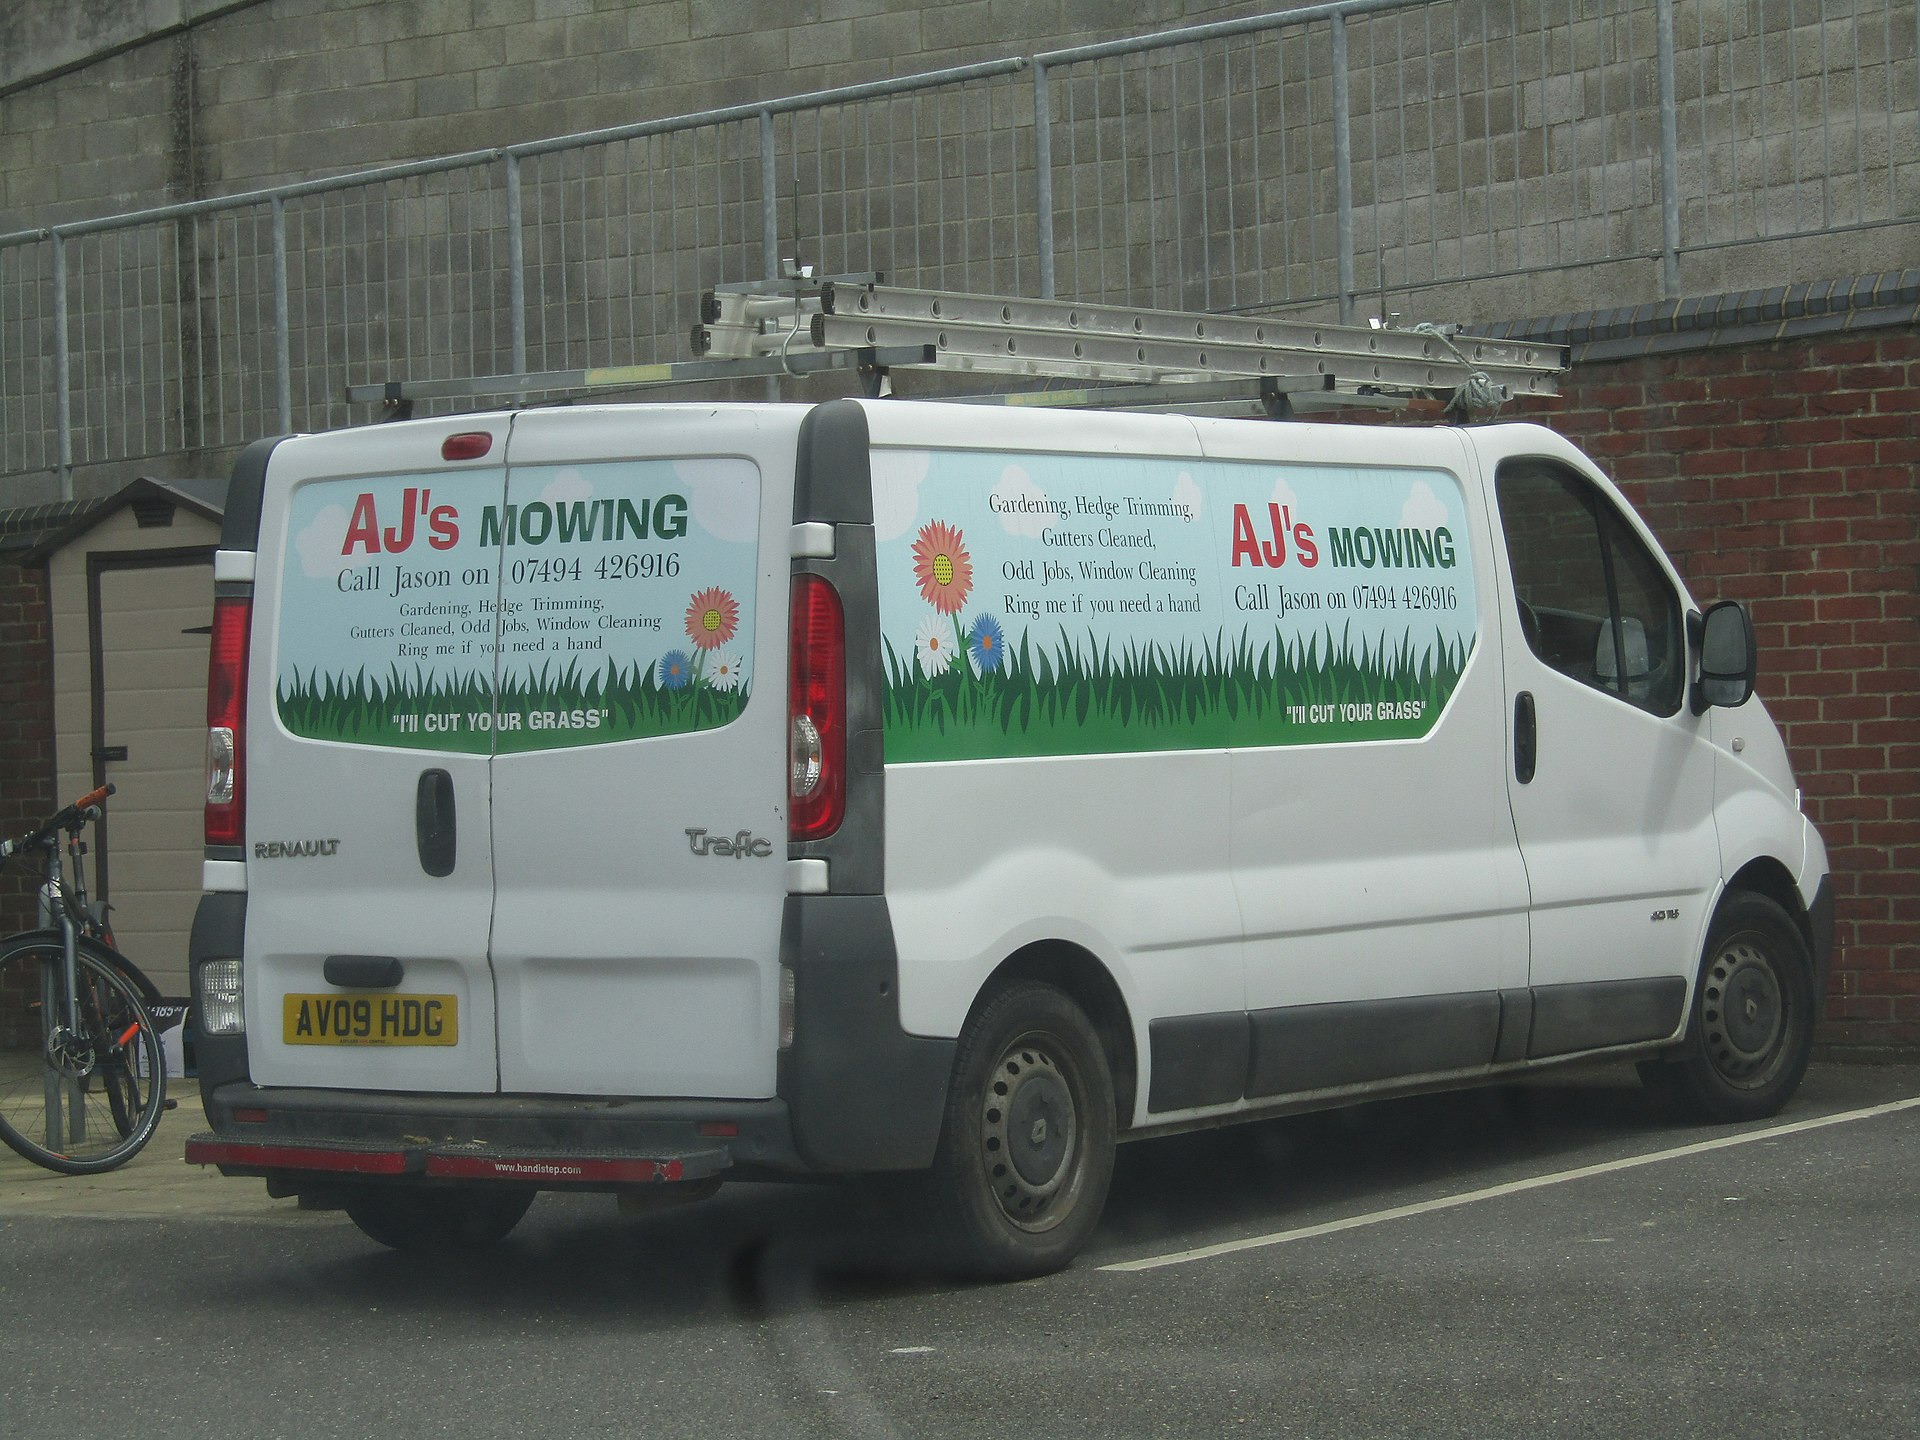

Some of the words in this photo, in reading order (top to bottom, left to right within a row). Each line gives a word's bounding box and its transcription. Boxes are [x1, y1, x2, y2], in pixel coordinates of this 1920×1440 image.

[989, 493, 1072, 521] Gardening,
[1075, 496, 1120, 521] Hedge
[1123, 496, 1194, 523] Trimming,
[341, 488, 459, 555] AJ's
[480, 494, 688, 547] MOWING
[1042, 527, 1094, 547] Gutters
[1098, 528, 1156, 550] Cleaned,
[1231, 502, 1319, 568] AJ's
[1328, 526, 1456, 569] MOWING
[337, 566, 380, 592] Call
[390, 565, 451, 597] Jason
[462, 568, 490, 585] on
[512, 558, 581, 584] 07494
[594, 553, 680, 581] 426916
[1002, 560, 1035, 580] Odd
[1042, 560, 1074, 586] Jobs,
[1078, 560, 1134, 580] Window
[1139, 561, 1197, 586] Cleaning
[400, 601, 471, 618] Gardening,
[479, 600, 523, 615] Hedge
[531, 596, 604, 613] Trimming,
[1004, 593, 1040, 620] Ring
[1046, 601, 1067, 613] me
[1072, 593, 1083, 613] if
[1090, 601, 1114, 619] you
[1120, 593, 1151, 613] need
[1157, 600, 1163, 612] a
[1168, 593, 1201, 612] hand
[1234, 584, 1269, 610] Call
[1277, 584, 1321, 619] Jason
[1327, 591, 1347, 610] on
[1352, 585, 1396, 610] 07494
[1402, 585, 1457, 610] 426916
[350, 625, 394, 639] Gutters
[401, 622, 454, 637] Cleaned,
[461, 619, 490, 633] Odd
[500, 619, 529, 636] Jobs,
[537, 616, 590, 631] Window
[598, 613, 662, 631] Cleaning
[398, 643, 428, 660] Ring
[436, 644, 455, 655] me
[462, 640, 472, 654] if
[480, 643, 505, 657] you
[513, 638, 544, 651] need
[552, 641, 560, 650] a
[567, 636, 603, 650] hand
[424, 712, 461, 733] CUT
[467, 712, 521, 731] YOUR
[528, 708, 609, 730] GRASS"
[1310, 704, 1335, 724] CUT
[1339, 703, 1373, 723] YOUR
[1377, 700, 1426, 720] GRASS"
[255, 838, 340, 859] RENAULT
[685, 827, 772, 859] Trafic
[297, 1000, 371, 1036] AV09
[381, 1000, 443, 1036] HDG
[495, 1163, 581, 1176] www.handistep.com
